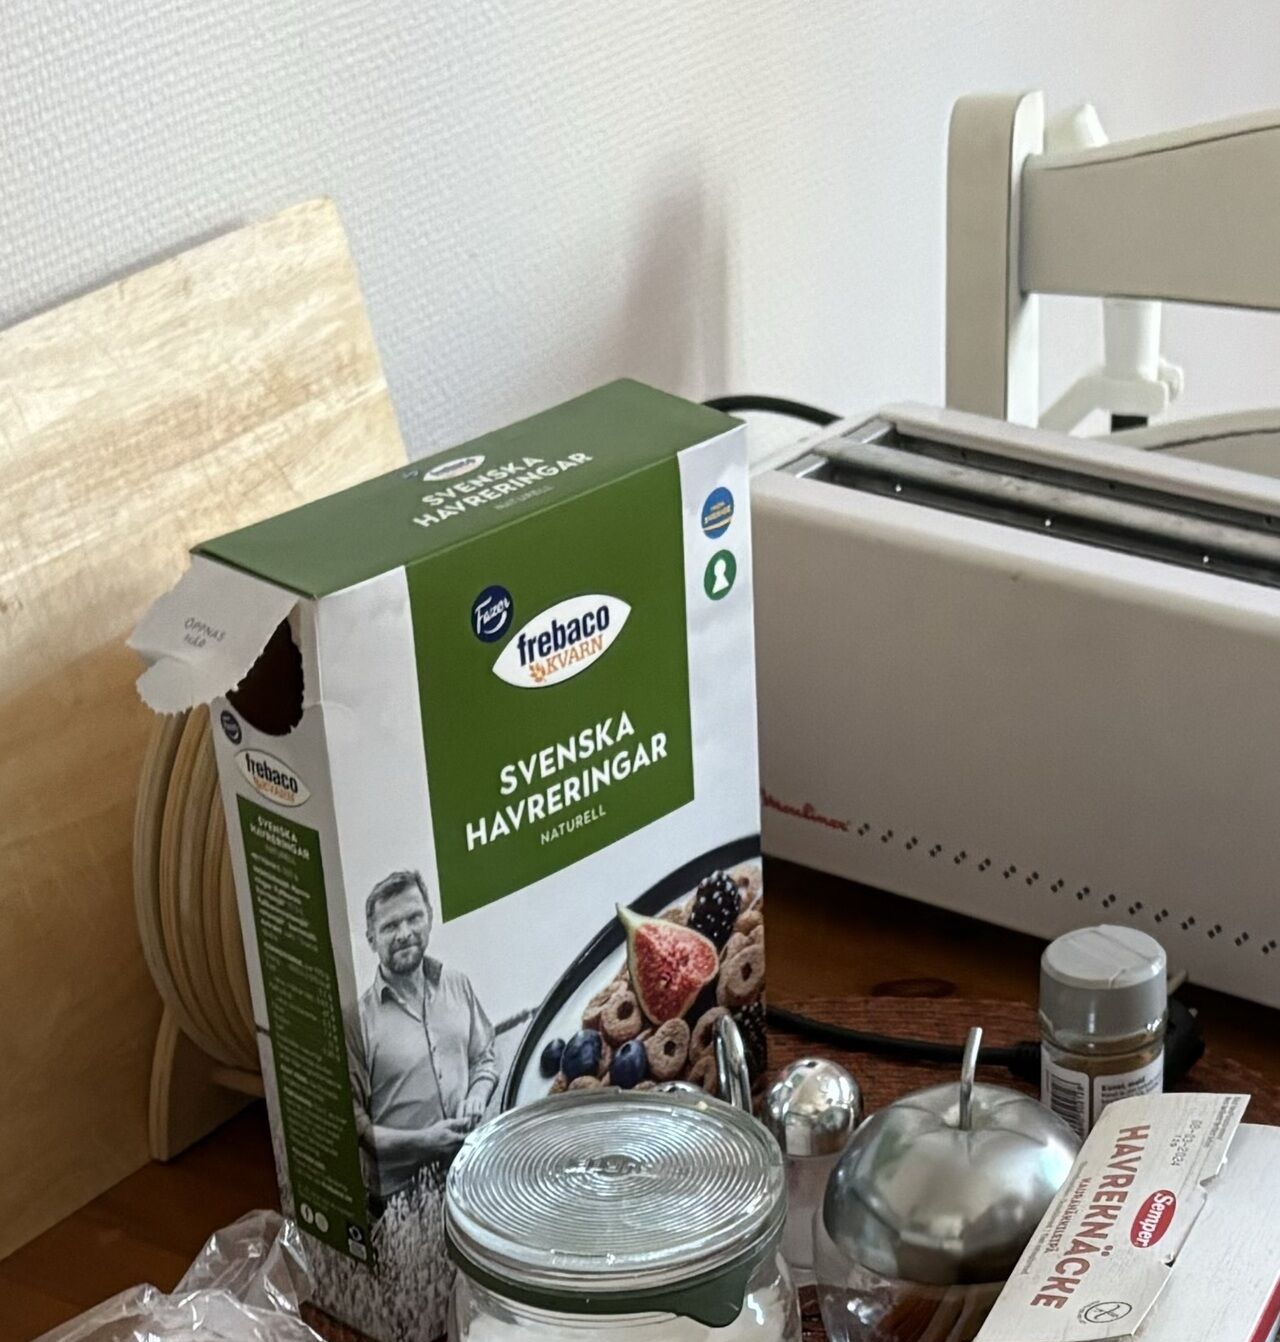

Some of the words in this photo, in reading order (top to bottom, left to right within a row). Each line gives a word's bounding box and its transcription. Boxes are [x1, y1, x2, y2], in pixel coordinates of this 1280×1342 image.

[412, 452, 594, 528] HAVRERINGAR
[421, 455, 545, 508] SVENSKA
[474, 596, 511, 635] Fazer
[516, 604, 611, 667] frebaco
[545, 633, 606, 677] KVARN
[245, 752, 299, 794] frebaco
[499, 709, 636, 796] SVENSKA
[465, 731, 669, 852] HAVRERINGAR
[539, 803, 607, 846] NATURELL
[1029, 1124, 1152, 1310] HAVREKNÄCKE
[1135, 1193, 1174, 1248] Semper
